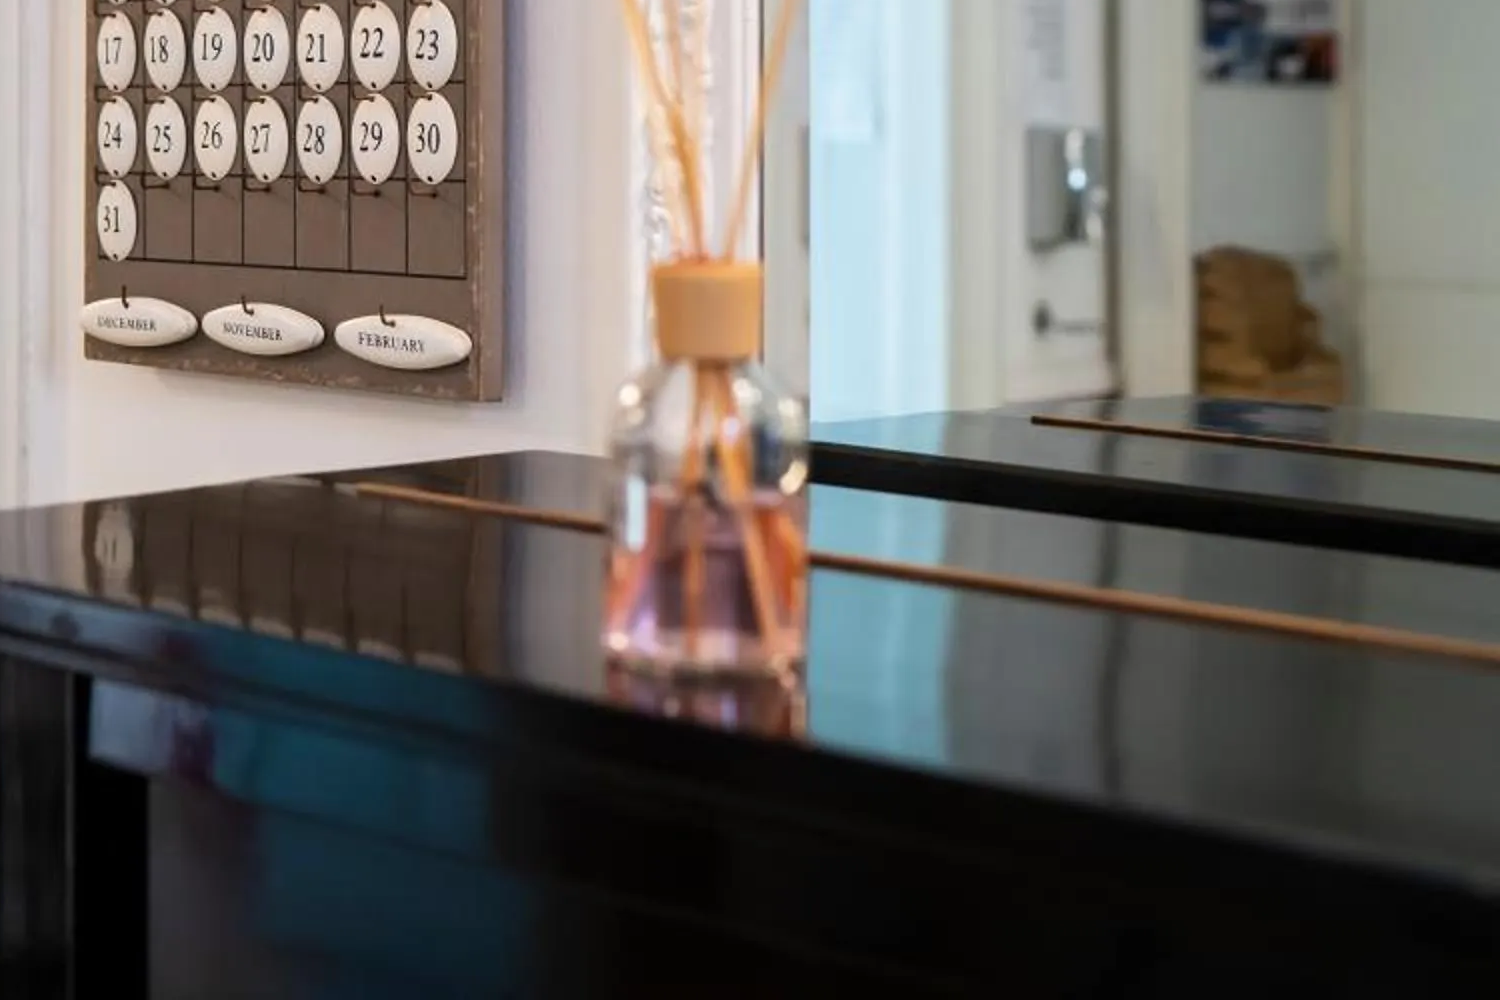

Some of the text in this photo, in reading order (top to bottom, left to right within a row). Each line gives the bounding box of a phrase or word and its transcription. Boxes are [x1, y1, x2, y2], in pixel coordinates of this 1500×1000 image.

[104, 27, 439, 65] 17 18 19 20 21 22 23
[103, 120, 441, 155] 24 25 26 27 28 29 30
[103, 205, 121, 233] 31
[98, 315, 158, 332] DECEMBER
[222, 320, 283, 341] NOVEMBER
[357, 331, 426, 353] FEBRUARY
